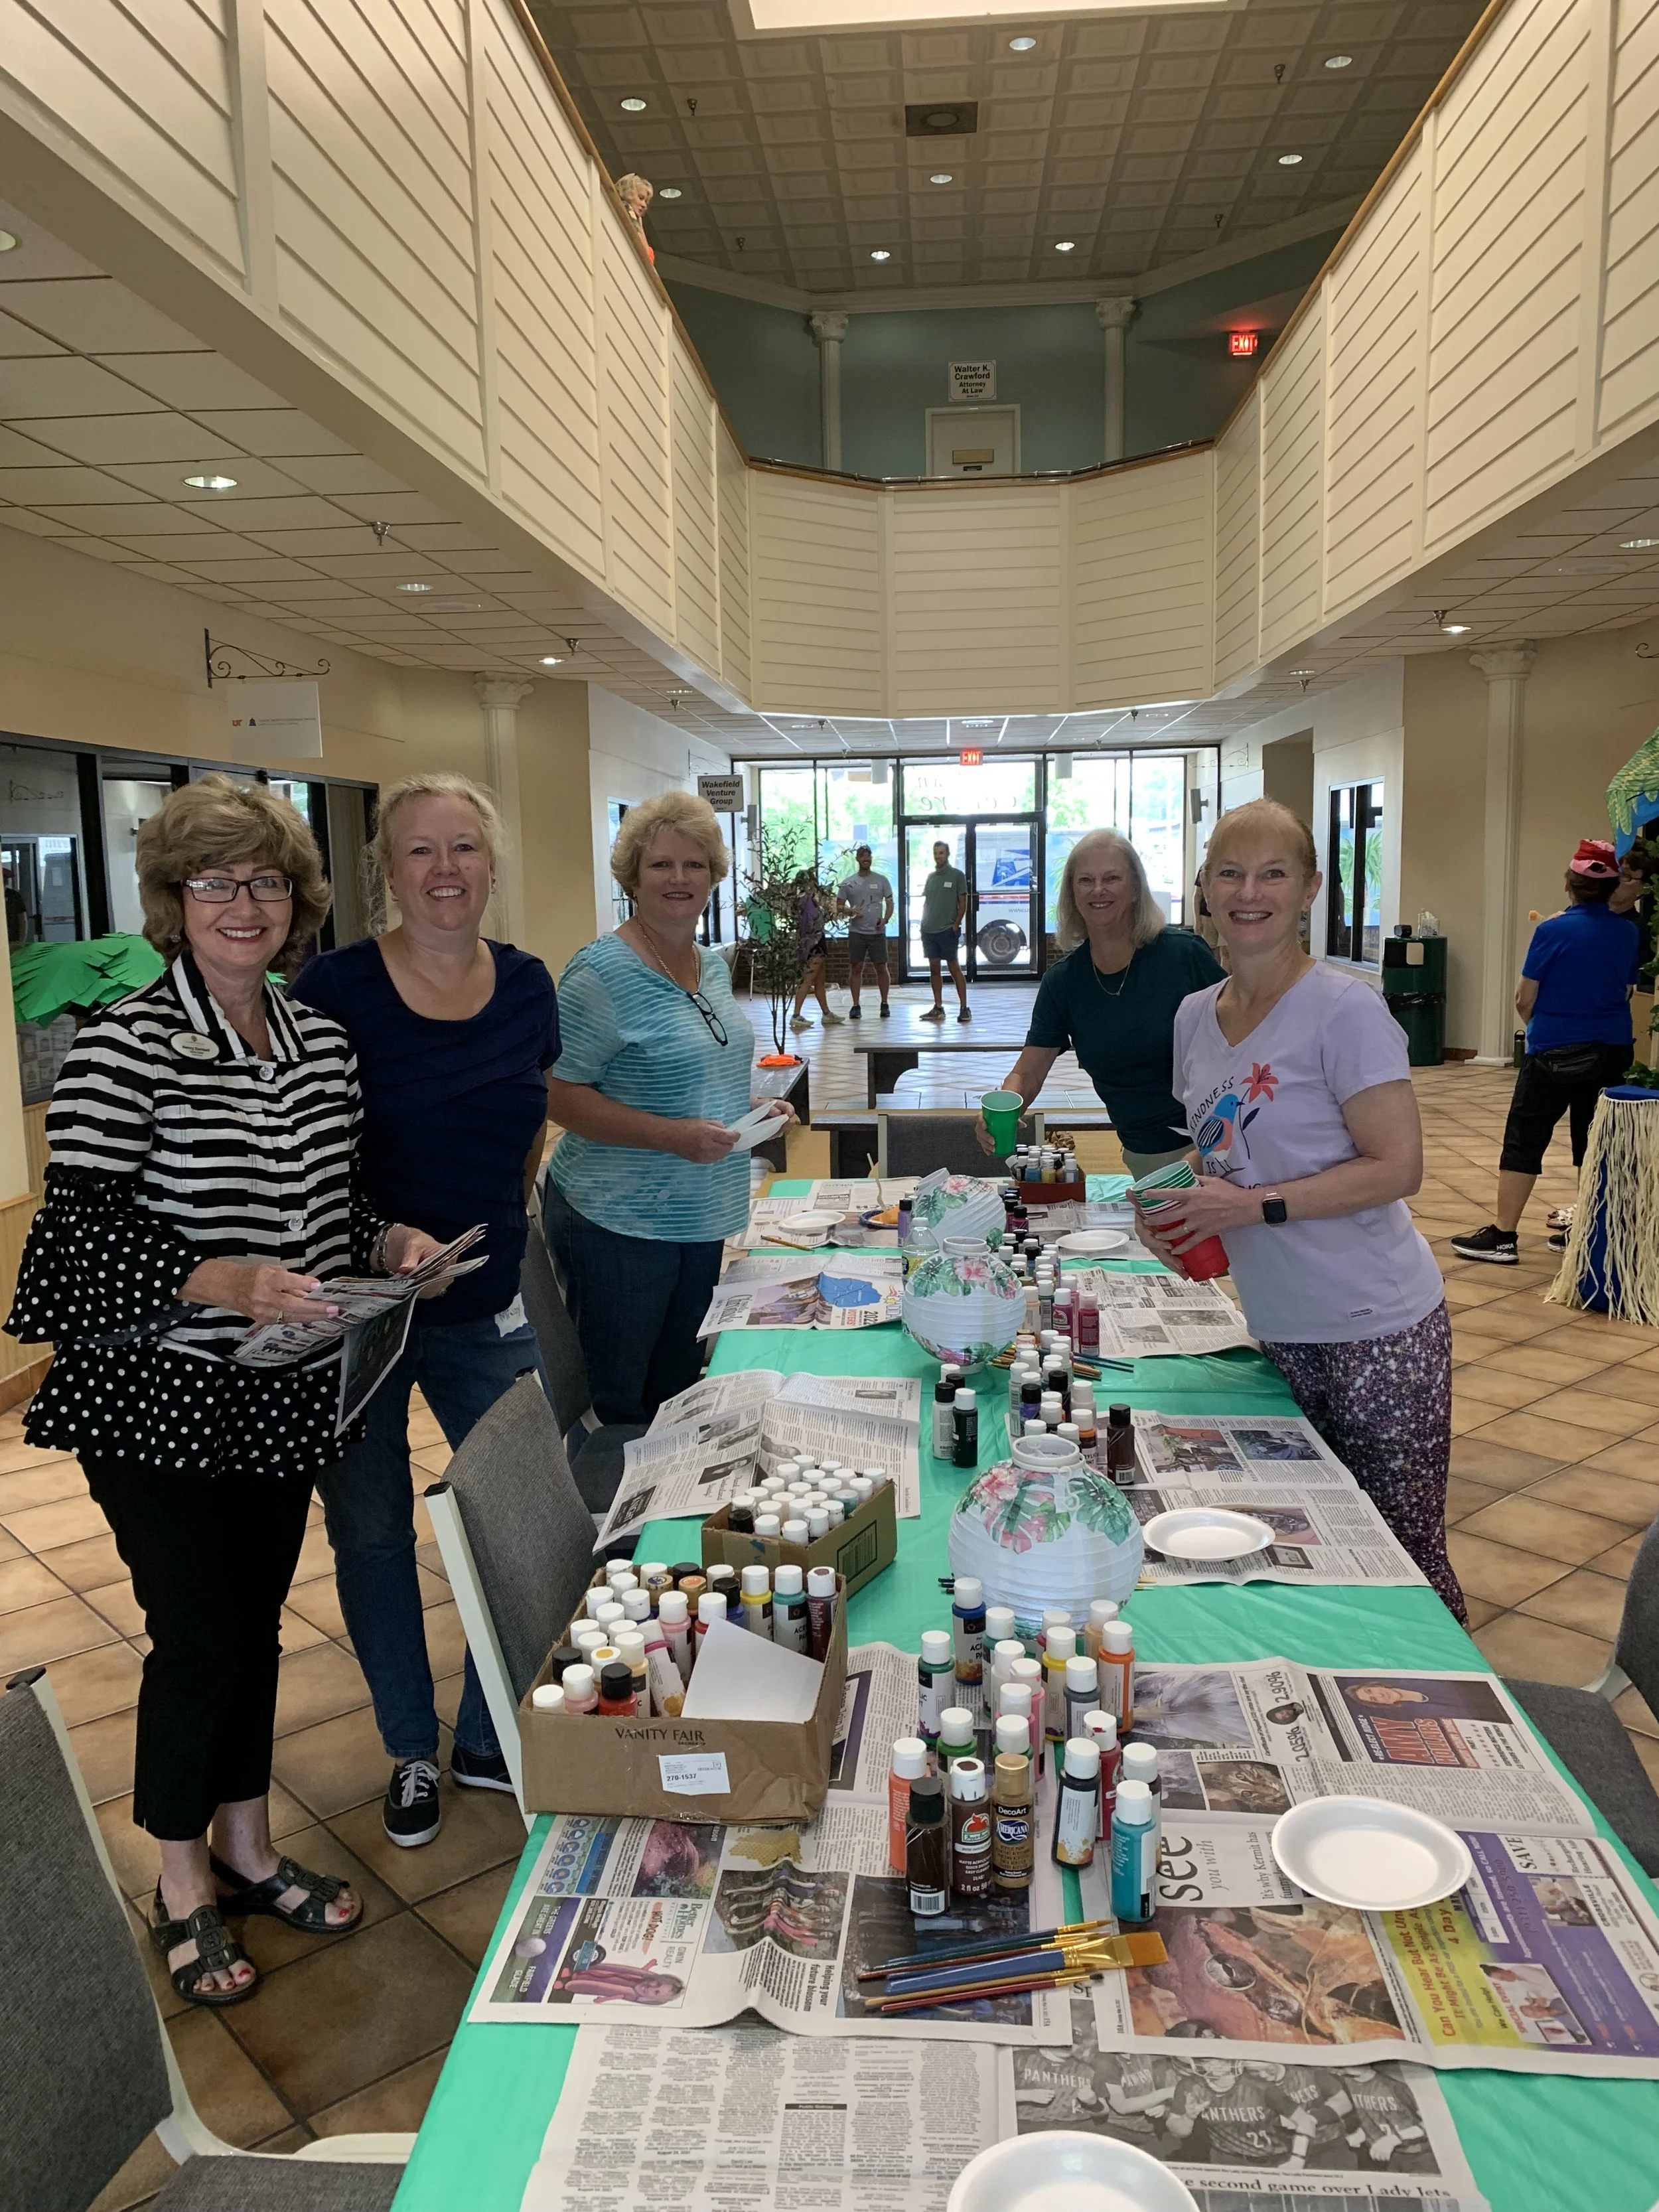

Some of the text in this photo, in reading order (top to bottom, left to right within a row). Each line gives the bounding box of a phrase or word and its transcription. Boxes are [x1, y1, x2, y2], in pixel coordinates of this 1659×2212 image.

[1232, 334, 1255, 351] EXIT
[962, 751, 981, 765] EXIT
[1190, 1076, 1234, 1132] KINDNESS
[1206, 1161, 1216, 1174] IS
[1266, 1671, 1289, 1703] 2.90%
[615, 1728, 705, 1741] VANITY FAIR
[1286, 1726, 1310, 1762] 2.05%
[1370, 1716, 1435, 1763] AMY
[1414, 1718, 1460, 1765] HOLLARS
[666, 1773, 697, 1782] 270-1537
[998, 1806, 1027, 1816] DecoArt
[997, 1823, 1028, 1834] AMERICANA
[1477, 1850, 1490, 1865] CALL
[1506, 1836, 1538, 1870] SAVE
[1196, 1840, 1229, 1891] you with
[1246, 1832, 1275, 1900] It's why Kermit has
[686, 1903, 703, 1927] Better
[1582, 1883, 1611, 1927] CROSSVILLE
[642, 1911, 663, 1942] HOT DOG!
[674, 1909, 688, 1939] Homes
[1439, 1908, 1457, 1933] Day
[1400, 1931, 1415, 1948] Not
[1413, 1923, 1435, 1951] Simple
[662, 1946, 676, 1969] REALTY
[675, 1947, 687, 1964] GWIN
[1407, 1949, 1425, 1966] But
[1429, 1951, 1441, 1965] As
[1418, 1967, 1436, 1991] Hear
[1435, 1966, 1447, 1979] Be
[804, 1964, 820, 2012] future blossom
[820, 1965, 835, 2006] Helping your
[1441, 1982, 1461, 2008] Might
[1429, 1994, 1445, 2014] You
[1453, 2010, 1466, 2020] It
[1480, 1986, 1509, 2029] We Can Help!
[1492, 1982, 1528, 2034] SPECIAL EVENT
[1439, 2016, 1457, 2037] Can
[1024, 2068, 1092, 2089] PANTHERS
[1202, 2106, 1266, 2123] ANTHERS
[1200, 2178, 1452, 2199] second game over Lady Jets
